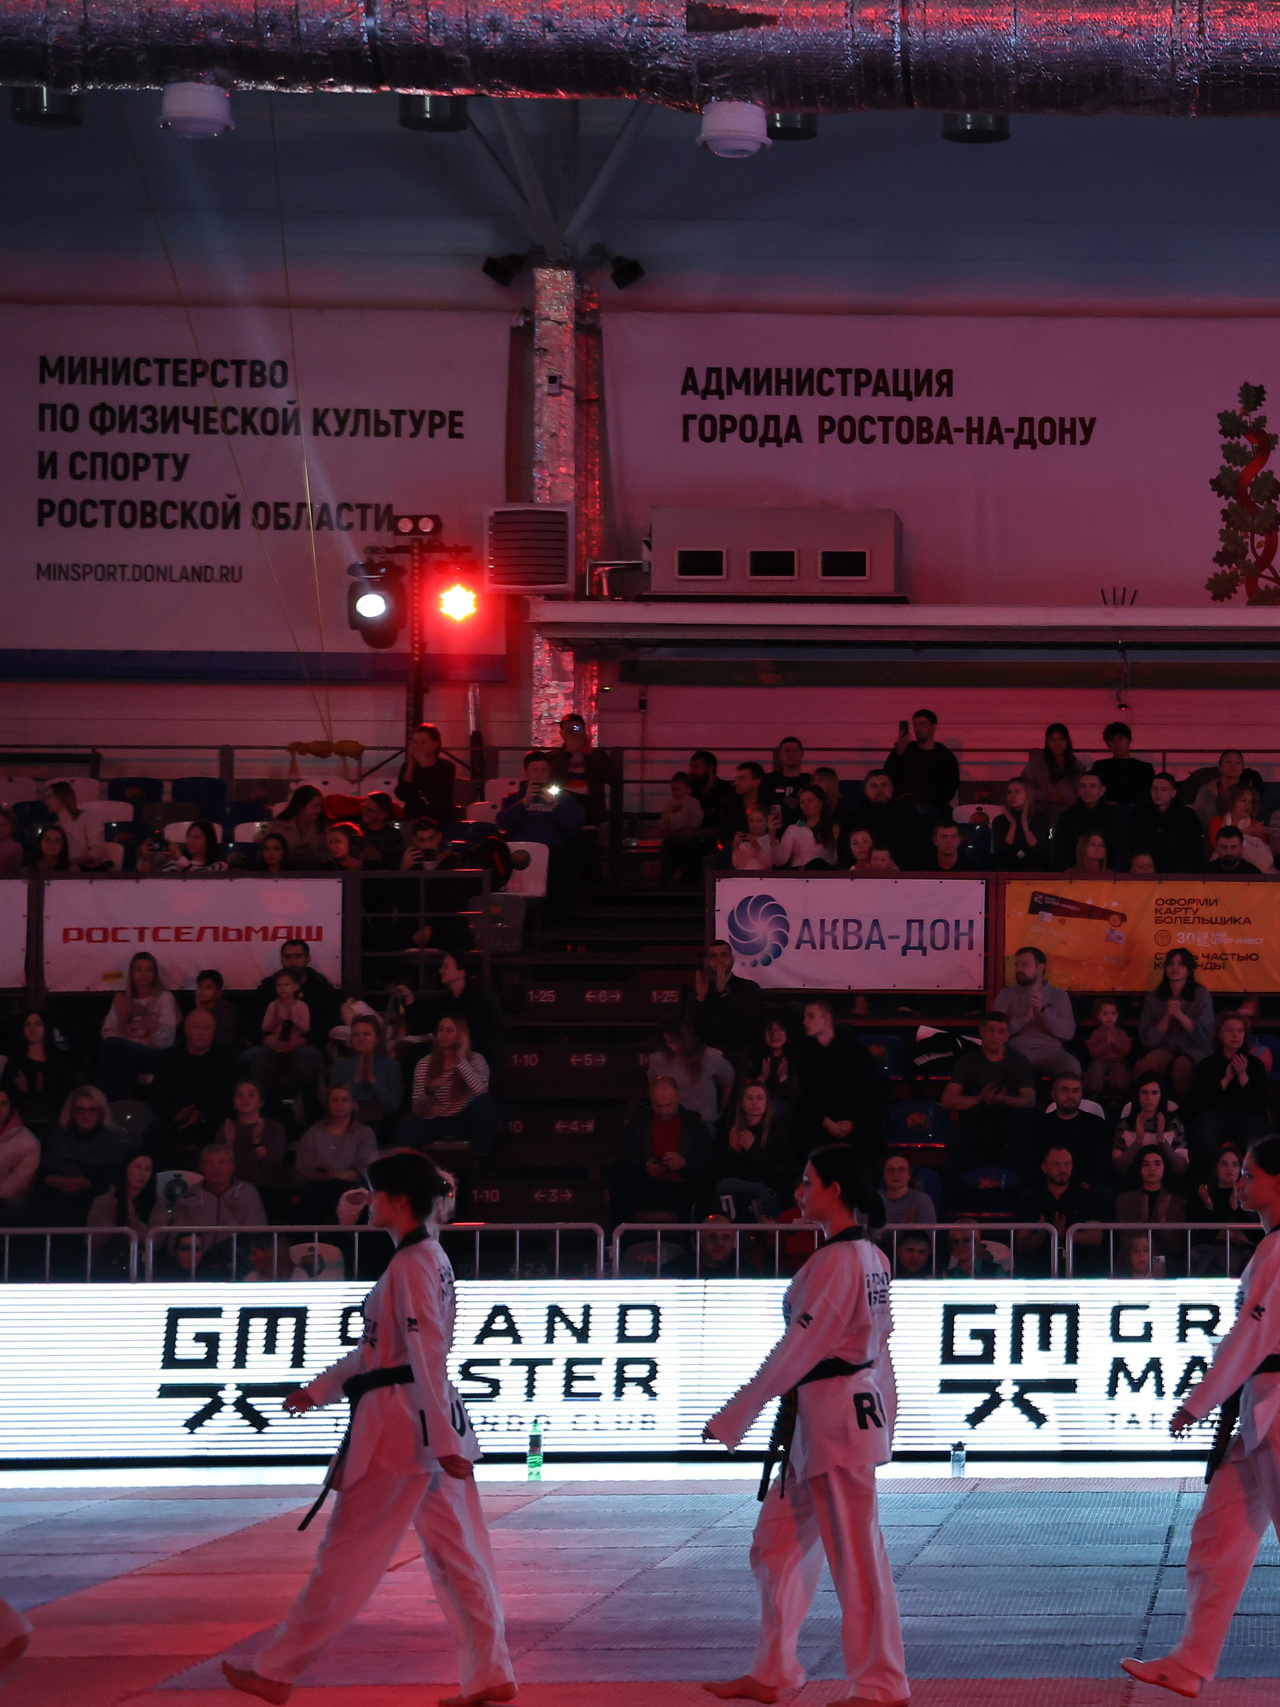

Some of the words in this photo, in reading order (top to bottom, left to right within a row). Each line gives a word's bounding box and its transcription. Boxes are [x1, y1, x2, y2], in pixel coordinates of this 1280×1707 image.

[38, 354, 290, 389] МИНИСТЕРСТВО
[681, 366, 954, 402] АДМИНИСТРАЦИЯ
[38, 403, 79, 433] ПО
[89, 400, 302, 437] ФИЗИЧЕСКОЙ
[312, 408, 465, 440] КУЛЬТУРЕ
[682, 413, 803, 448] ГОРОДА
[818, 415, 1097, 450] РОСТОВА-НА-ДОНУ
[38, 451, 58, 480] И
[69, 451, 190, 483] СПОРТУ
[37, 494, 241, 531] РОСТОВСКОЙ
[253, 502, 396, 533] ОБЛАСТИ
[37, 563, 243, 584] MINSPORT.DONLAND.RU
[1155, 898, 1218, 907] ОФОРМИ
[1155, 916, 1251, 925] БОЛЕЛЬЩИКА
[62, 926, 323, 943] РОСТСЕЛЬМАШ
[795, 919, 974, 956] АКВА-ДОН
[1202, 953, 1259, 961] ЧАСТЬЮ
[528, 991, 556, 1002] 1-25
[652, 990, 679, 1002] 1-25
[512, 1054, 538, 1066] 1-10
[472, 1190, 500, 1201] 1-10
[459, 1357, 658, 1401] STER
